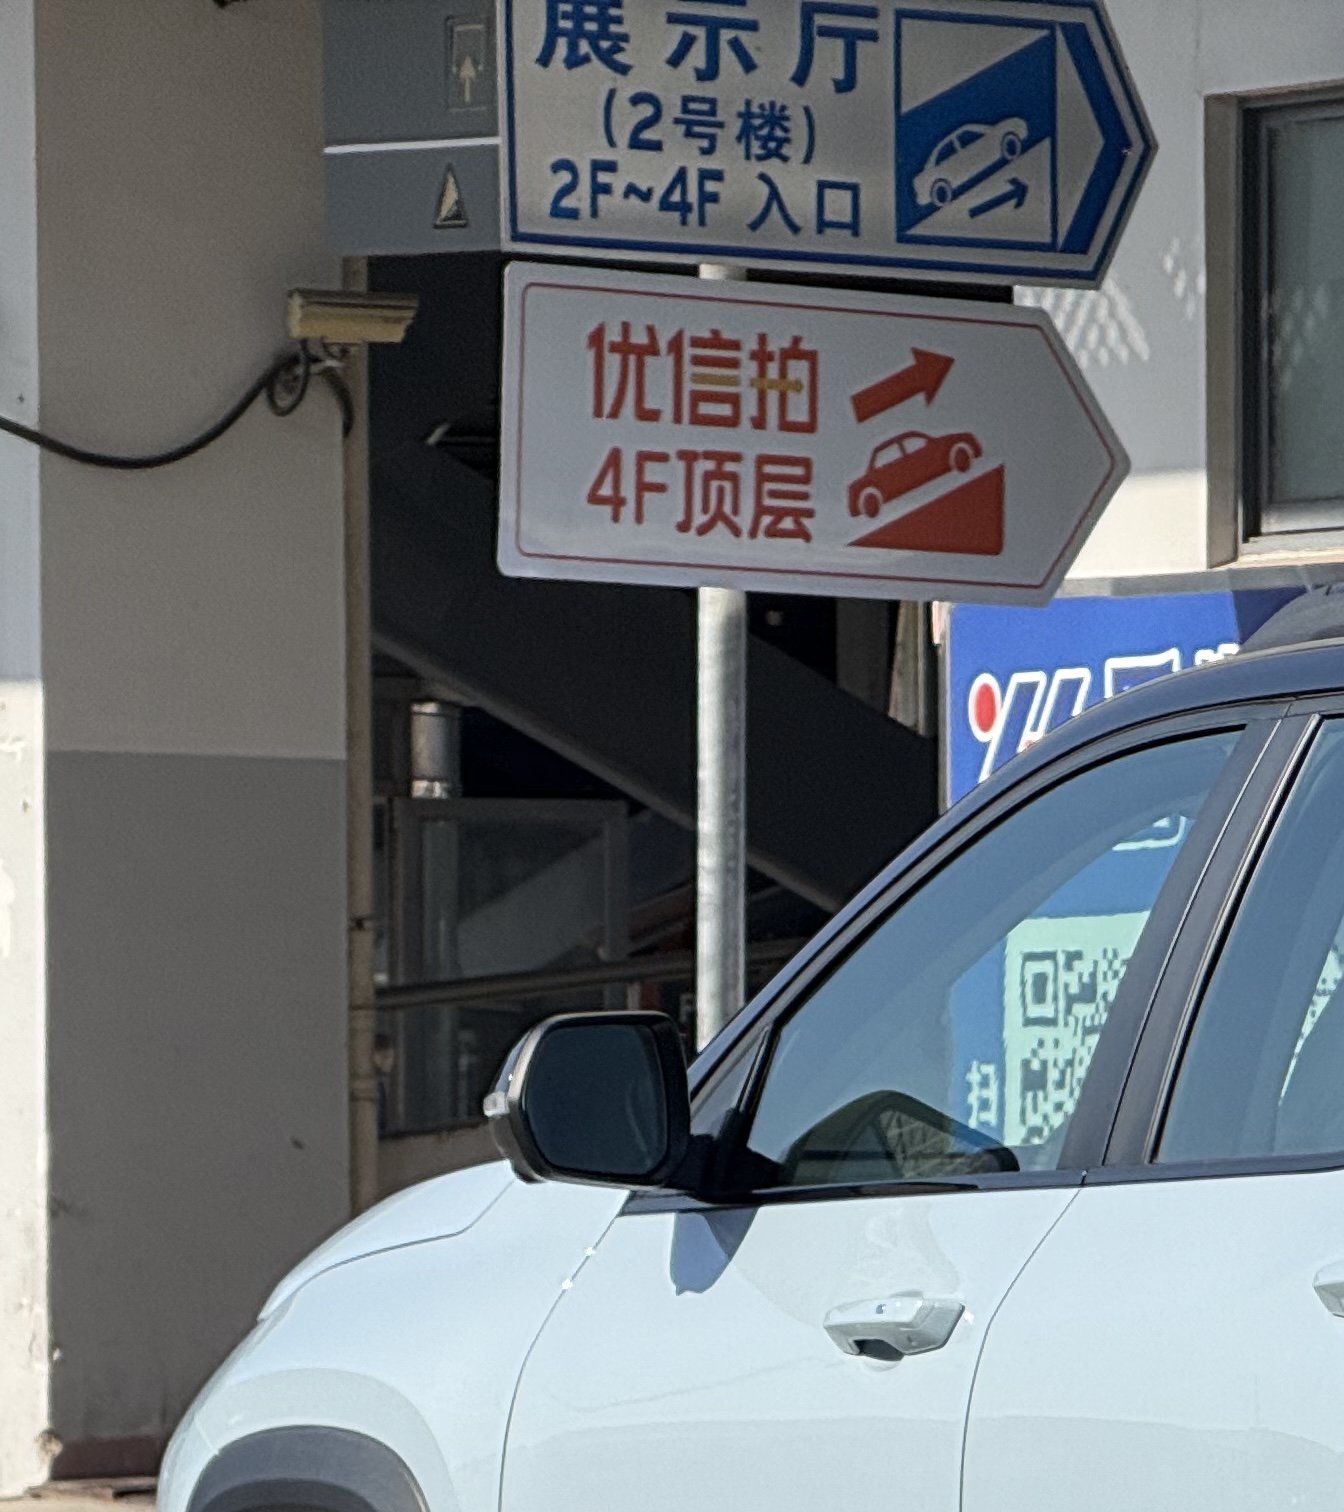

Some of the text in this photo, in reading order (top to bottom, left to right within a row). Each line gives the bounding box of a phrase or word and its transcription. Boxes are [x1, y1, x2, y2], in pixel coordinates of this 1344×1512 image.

[535, 0, 880, 93] 展示厅
[747, 172, 861, 237] 入口
[587, 321, 819, 433] 优信拍
[587, 447, 816, 539] 4F顶层
